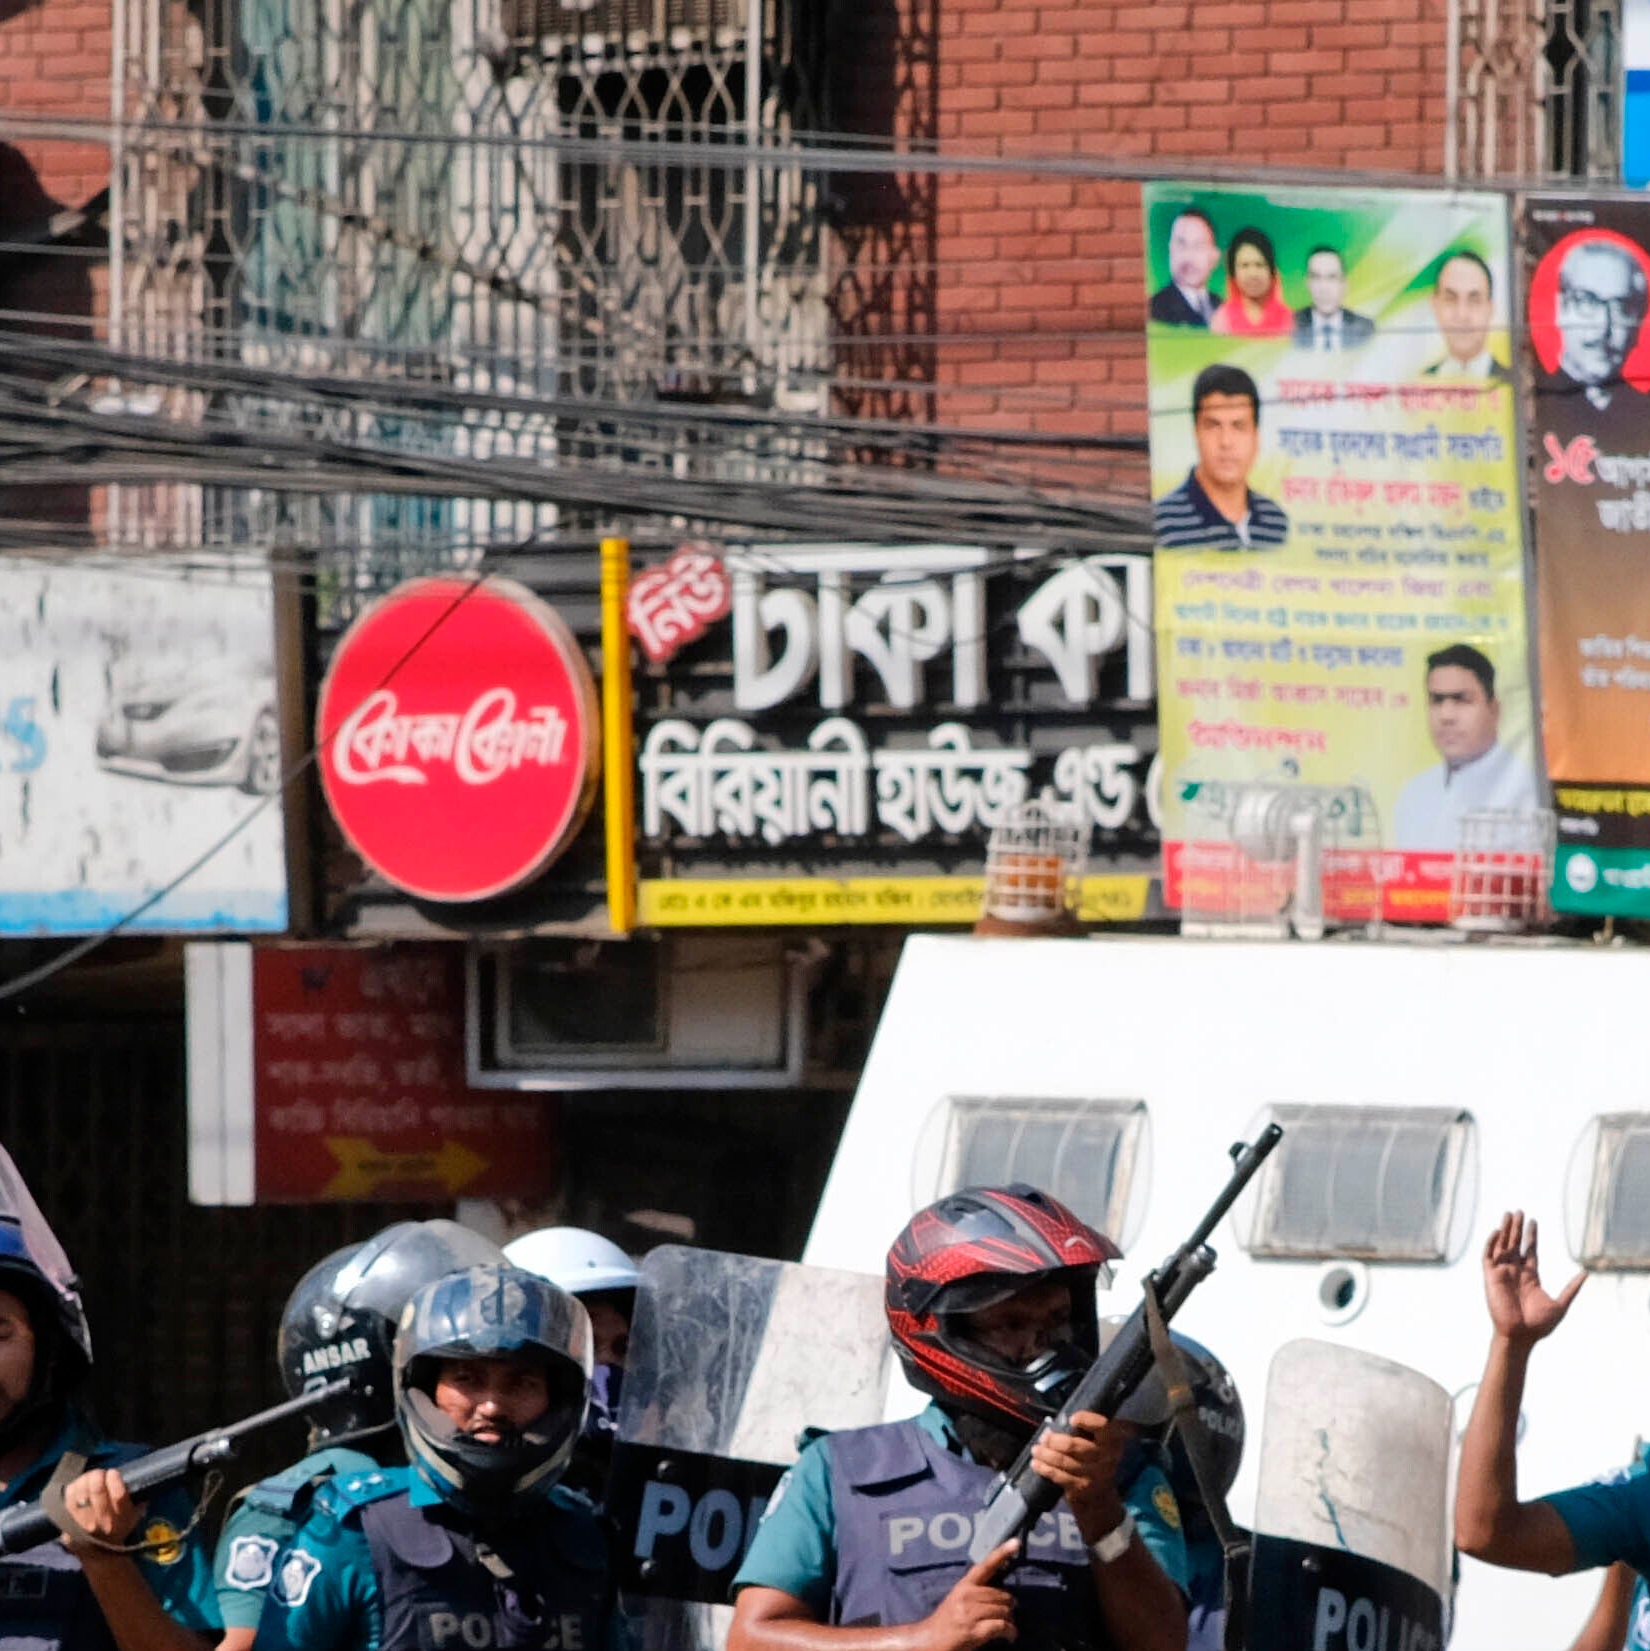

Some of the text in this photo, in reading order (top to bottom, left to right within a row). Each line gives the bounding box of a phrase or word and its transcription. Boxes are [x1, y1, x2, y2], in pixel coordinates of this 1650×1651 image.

[639, 719, 869, 846] বিরিয়ানী
[873, 721, 1030, 842] হাউজ
[303, 1337, 372, 1377] ANSAR
[889, 1512, 1084, 1556] POCE
